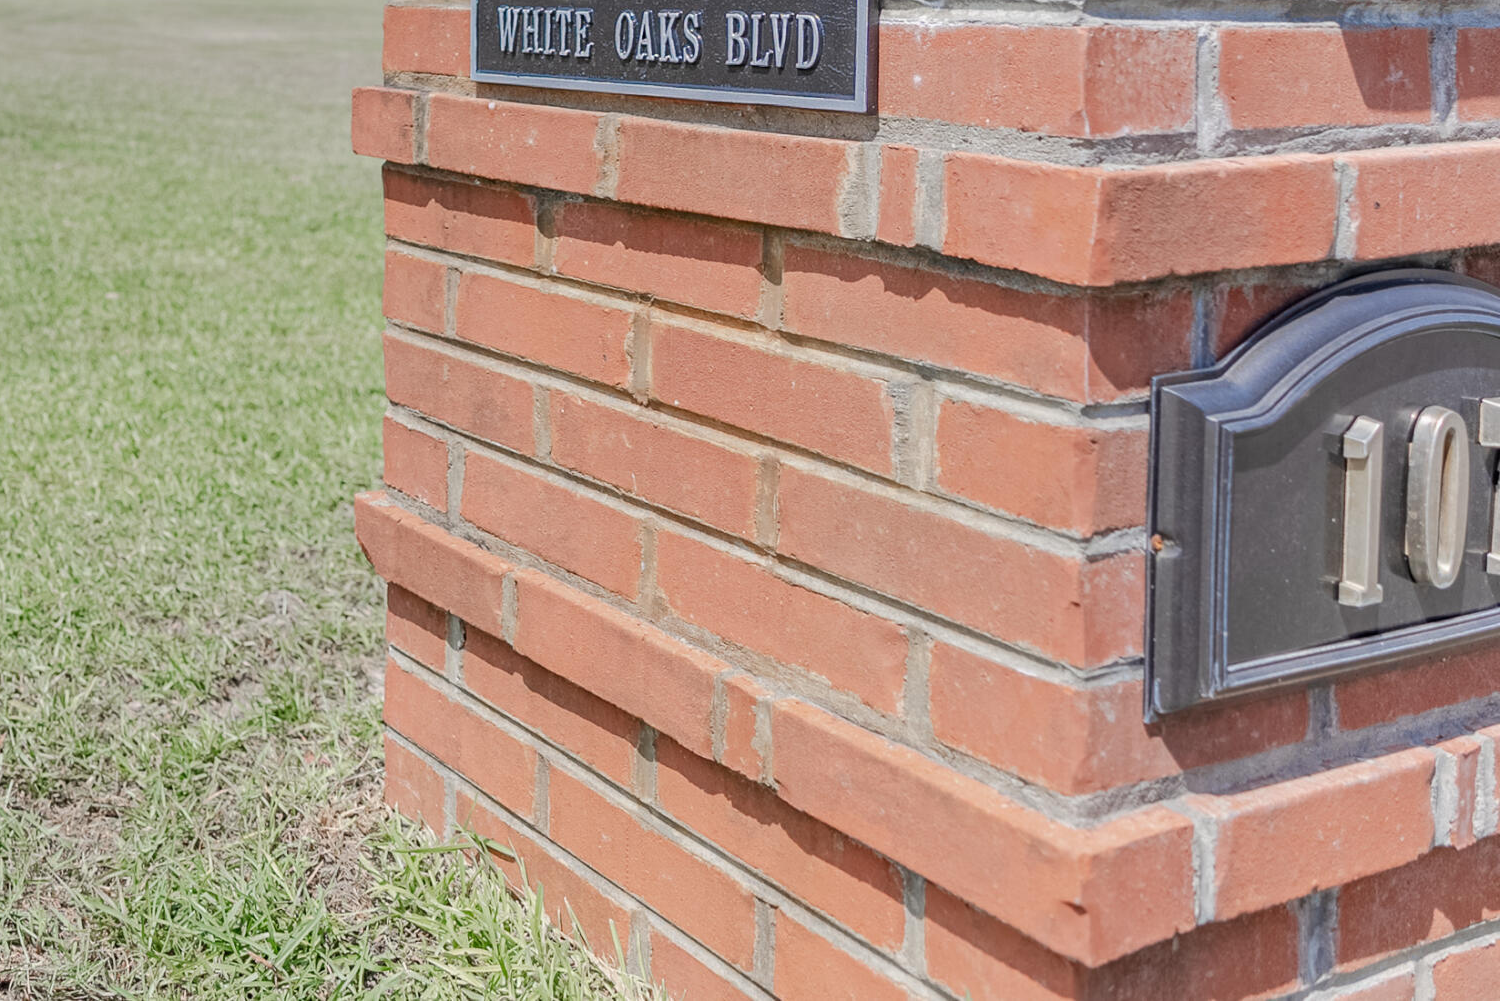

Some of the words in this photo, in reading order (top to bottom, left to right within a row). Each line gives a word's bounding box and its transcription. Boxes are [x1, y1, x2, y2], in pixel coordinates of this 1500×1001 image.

[497, 6, 594, 58] WHITE
[614, 8, 703, 64] OAKS
[724, 10, 824, 70] BLVD
